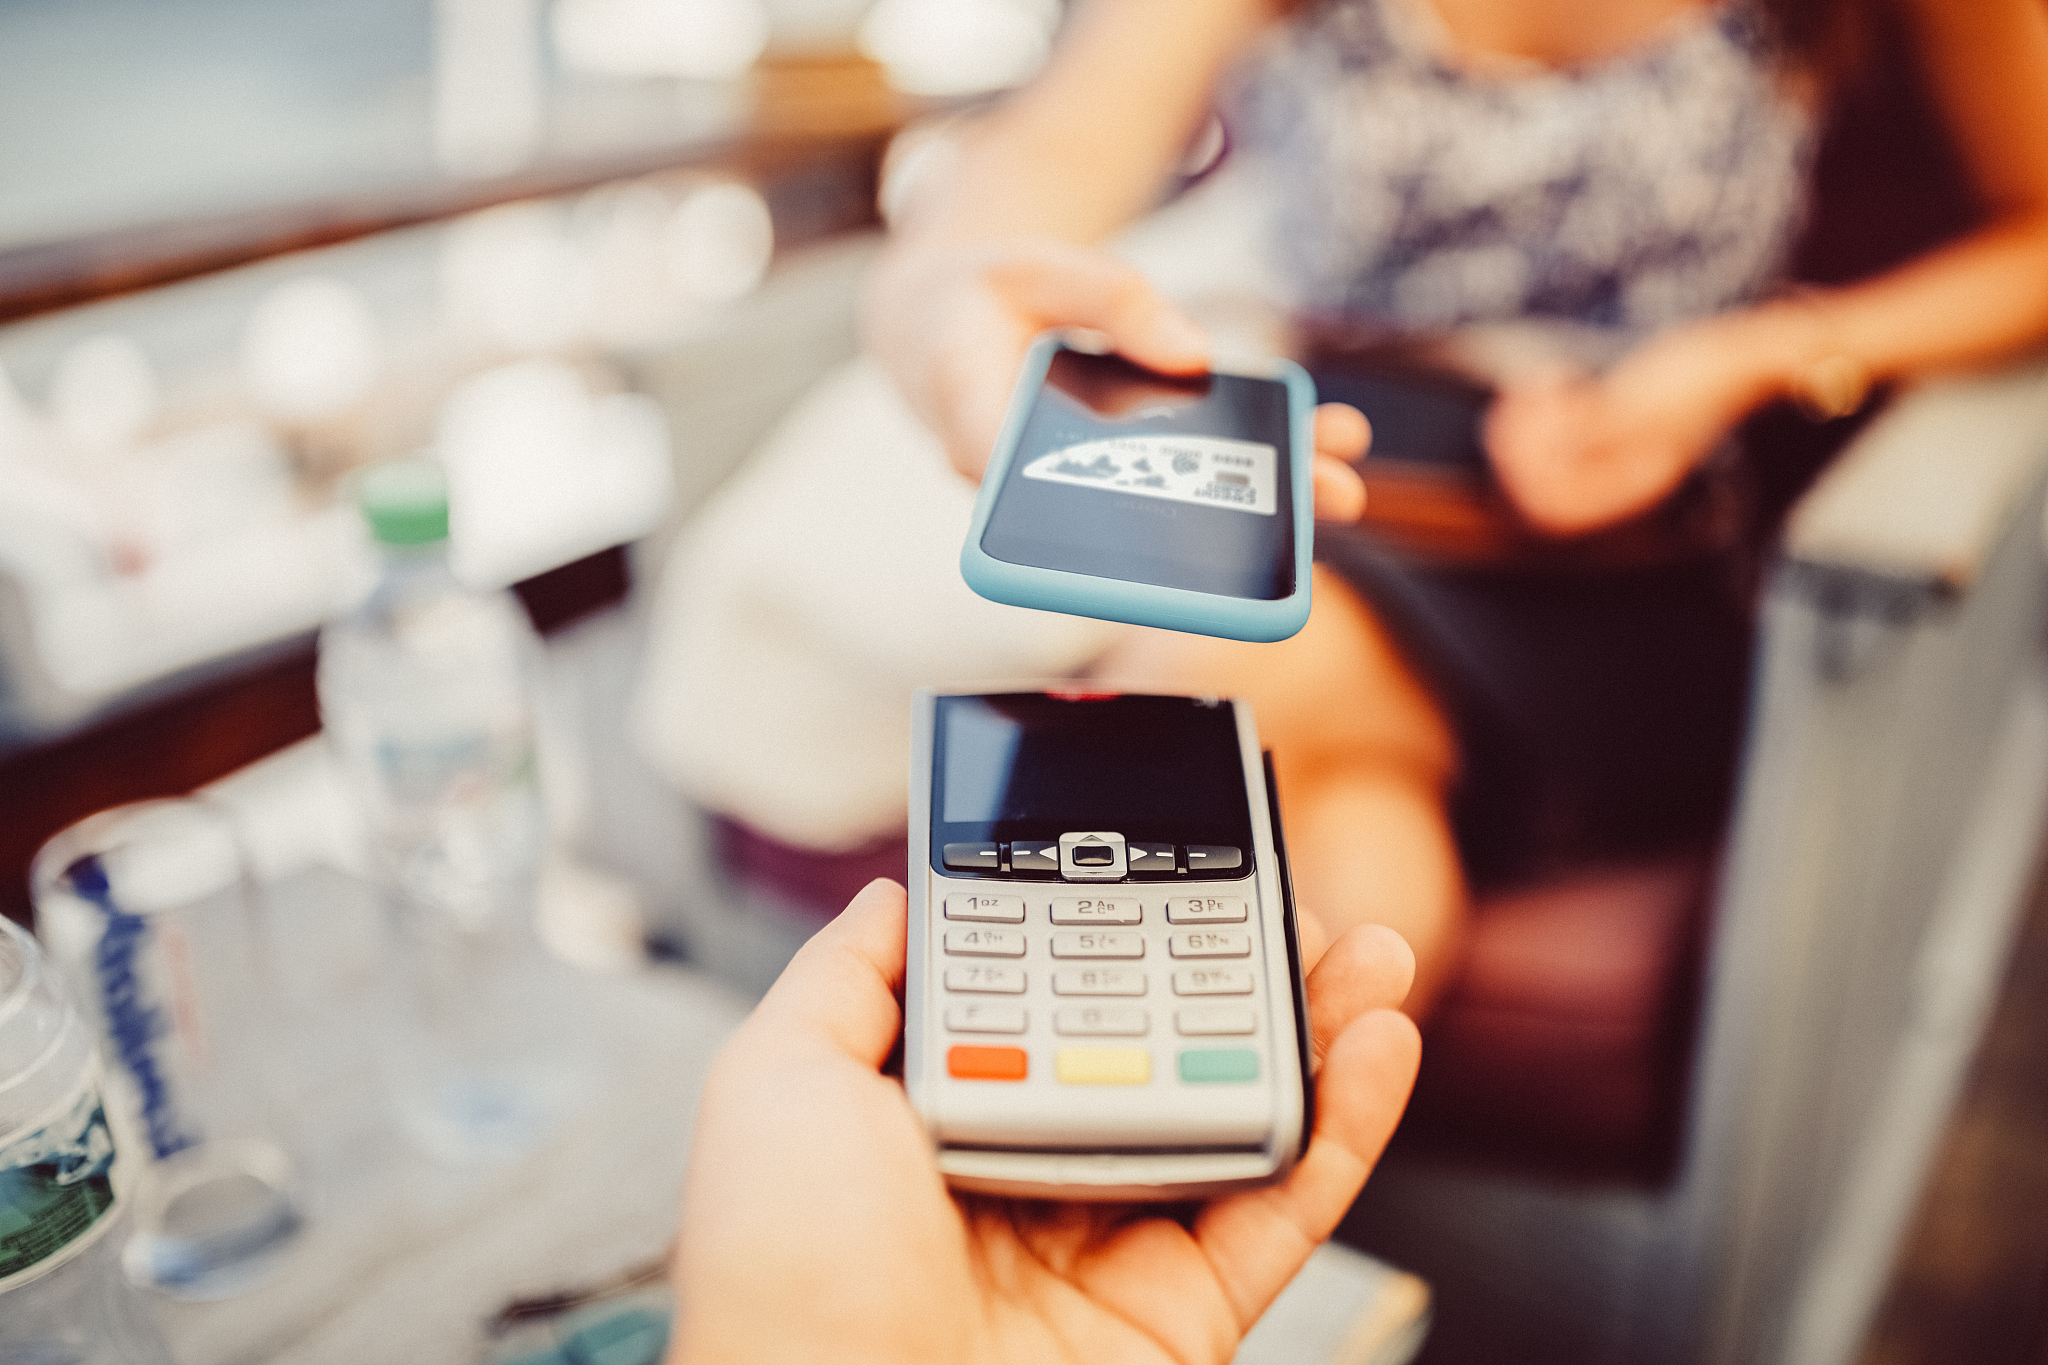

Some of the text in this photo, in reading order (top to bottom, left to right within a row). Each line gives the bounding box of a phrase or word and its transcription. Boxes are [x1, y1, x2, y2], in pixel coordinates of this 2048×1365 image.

[966, 897, 978, 910] 1
[1077, 900, 1093, 914] 2
[1188, 899, 1204, 913] 3
[964, 932, 979, 945] 4
[1079, 934, 1095, 949] 5
[1188, 934, 1203, 949] 6
